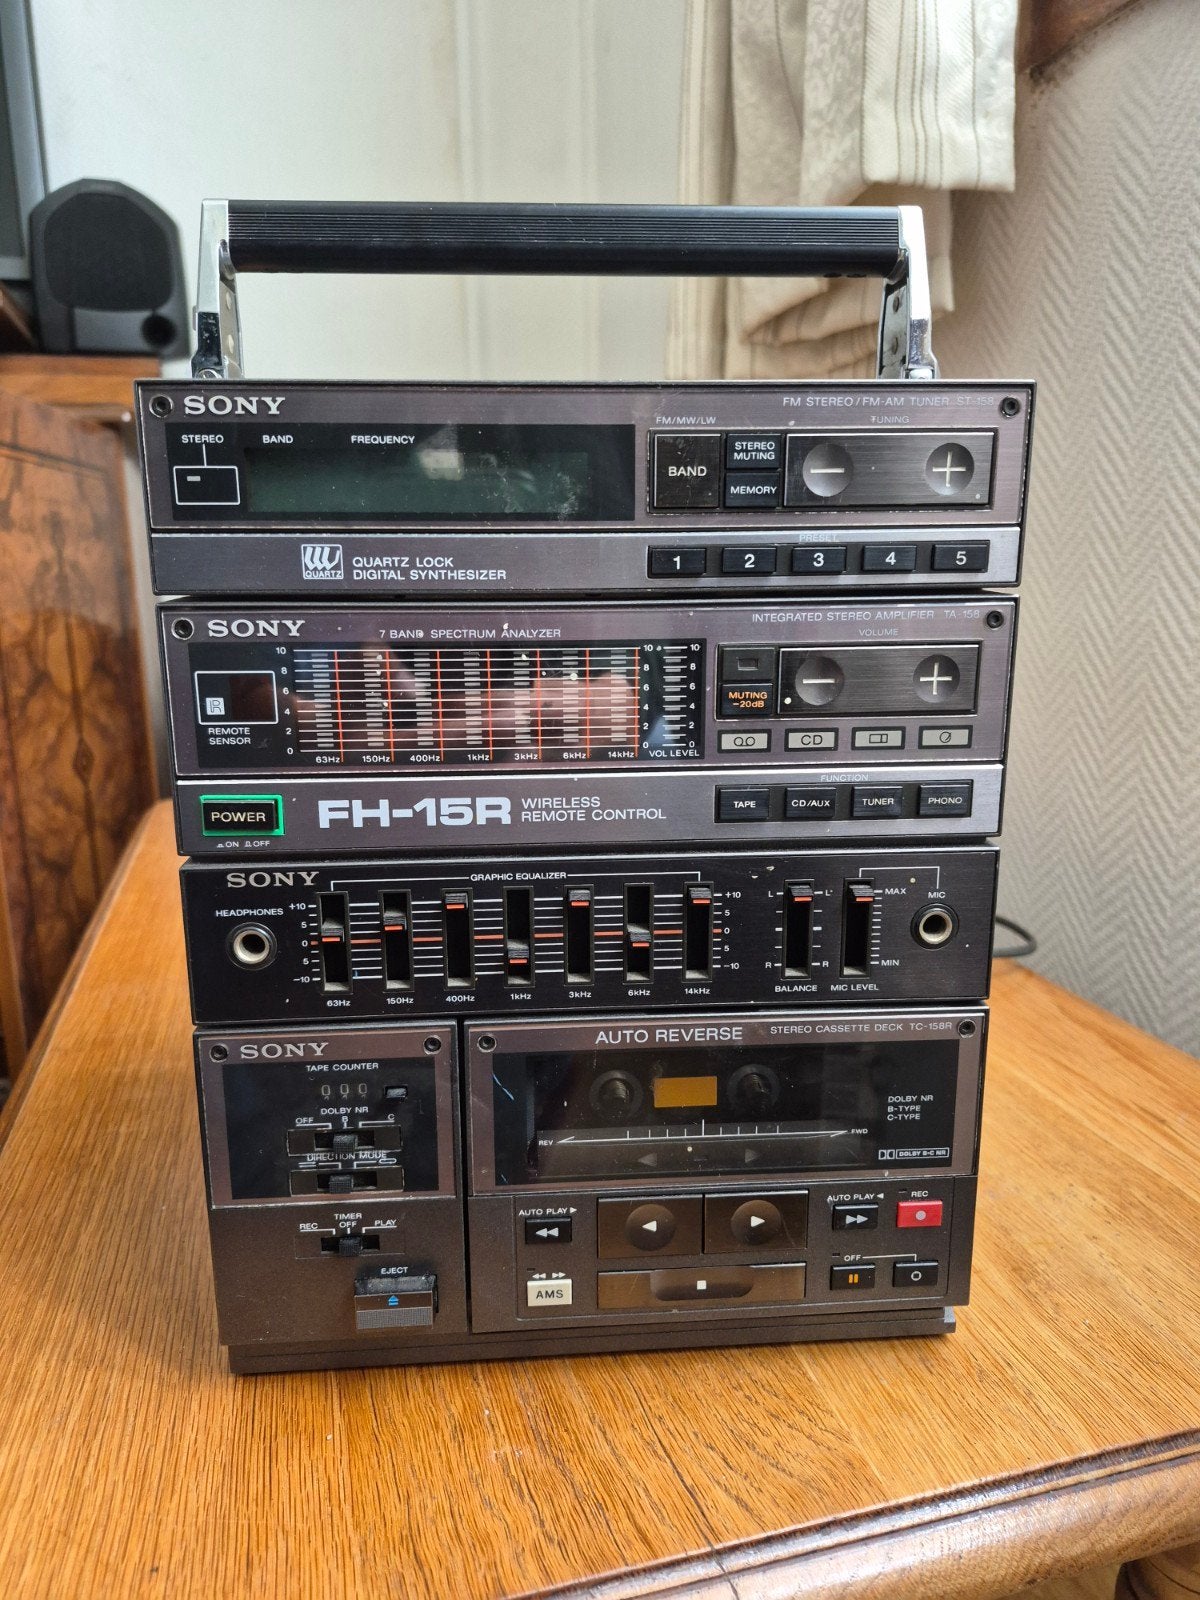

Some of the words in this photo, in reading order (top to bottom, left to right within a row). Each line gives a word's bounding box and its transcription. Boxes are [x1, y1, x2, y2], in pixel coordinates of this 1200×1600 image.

[183, 396, 286, 416] SONY
[783, 397, 801, 407] FM
[910, 397, 950, 406] TUNER
[655, 415, 717, 425] FM/MW/LW
[870, 415, 910, 424] TUNING
[181, 434, 224, 444] STEREO
[262, 434, 294, 444] BAND
[350, 434, 416, 445] FREQUENCY
[734, 441, 776, 451] STEREO
[733, 451, 776, 461] MUTING
[667, 465, 707, 477] BAND
[729, 485, 778, 495] MEMORY
[799, 534, 838, 542] PRESET
[352, 556, 409, 569] QUARTZ
[415, 556, 454, 568] LOCK
[673, 555, 682, 570] 1
[744, 554, 755, 568] 2
[812, 552, 825, 567] 3
[884, 551, 897, 566] 4
[954, 550, 967, 566] 5
[305, 569, 342, 578] QUARTZ
[352, 569, 406, 581] DIGITAL
[410, 569, 507, 581] SYNTHESIZER
[752, 612, 823, 623] INTEGRATED
[826, 611, 872, 621] STEREO
[874, 610, 934, 621] AMPLIFIER
[207, 620, 305, 637] SONY
[858, 628, 899, 637] VOLUME
[380, 630, 386, 638] 7
[389, 630, 424, 639] BAND
[430, 628, 496, 639] SPECTRUM
[501, 628, 561, 638] ANALYZER
[276, 647, 286, 655] 10
[643, 644, 653, 652] 10
[690, 644, 700, 652] 10
[283, 687, 289, 695] 6
[728, 691, 768, 700] MUTING
[733, 700, 765, 708] -20dB
[284, 708, 291, 716] 4
[643, 722, 649, 730] 2
[689, 721, 695, 729] 2
[209, 737, 251, 745] SENSOR
[801, 735, 823, 746] CD
[287, 747, 294, 755] 0
[608, 751, 635, 759] 14kHz
[670, 749, 699, 757] LEVEL
[362, 755, 391, 763] 150Hz
[409, 754, 441, 763] 400Hz
[467, 753, 490, 761] 1kHz
[515, 753, 538, 761] 3kHz
[820, 774, 869, 782] FUNCTION
[522, 797, 601, 809] WIRELESS
[862, 798, 894, 806] TUNER
[211, 812, 266, 822] POWER
[317, 796, 512, 829] FH-15R
[521, 810, 586, 822] REMOTE
[592, 809, 667, 821] CONTROL
[226, 871, 319, 888] SONY
[470, 873, 514, 881] GRAPHIC
[515, 871, 567, 880] EQUALIZER
[725, 891, 741, 899] +10
[928, 891, 946, 899] MIC
[289, 902, 306, 910] +10
[215, 908, 284, 917] HEADPHONES
[724, 909, 731, 917] 5
[724, 927, 730, 935] 0
[724, 962, 740, 970] -10
[628, 989, 651, 997] 6kHz
[684, 987, 710, 995] 14kHz
[774, 985, 818, 993] BALANCE
[386, 997, 414, 1005] 150Hz
[445, 995, 475, 1003] 400Hz
[770, 1025, 812, 1034] STEREO
[815, 1024, 870, 1033] CASSETTE
[874, 1023, 903, 1032] DECK
[595, 1030, 649, 1045] AUTO
[655, 1027, 743, 1043] REVERSE
[240, 1042, 329, 1059] SONY
[306, 1064, 329, 1072] TAPE
[332, 1062, 379, 1071] COUNTER
[888, 1095, 918, 1103] DOLBY
[921, 1094, 934, 1102] NR
[320, 1107, 352, 1115] DOLBY
[355, 1106, 369, 1114] NR
[887, 1113, 921, 1121] C-TYPE
[306, 1152, 356, 1162] DIRECTION
[358, 1151, 387, 1160] MODE
[827, 1194, 851, 1202] AUTO
[853, 1193, 875, 1201] PLAY
[911, 1190, 929, 1198] REC
[518, 1208, 543, 1216] AUTO
[546, 1207, 568, 1215] PLAY
[334, 1212, 362, 1221] TIMER
[299, 1222, 318, 1230] REC
[339, 1221, 357, 1229] OFF
[374, 1219, 397, 1227] PLAY
[380, 1266, 409, 1275] EJECT
[535, 1289, 564, 1299] AMS
